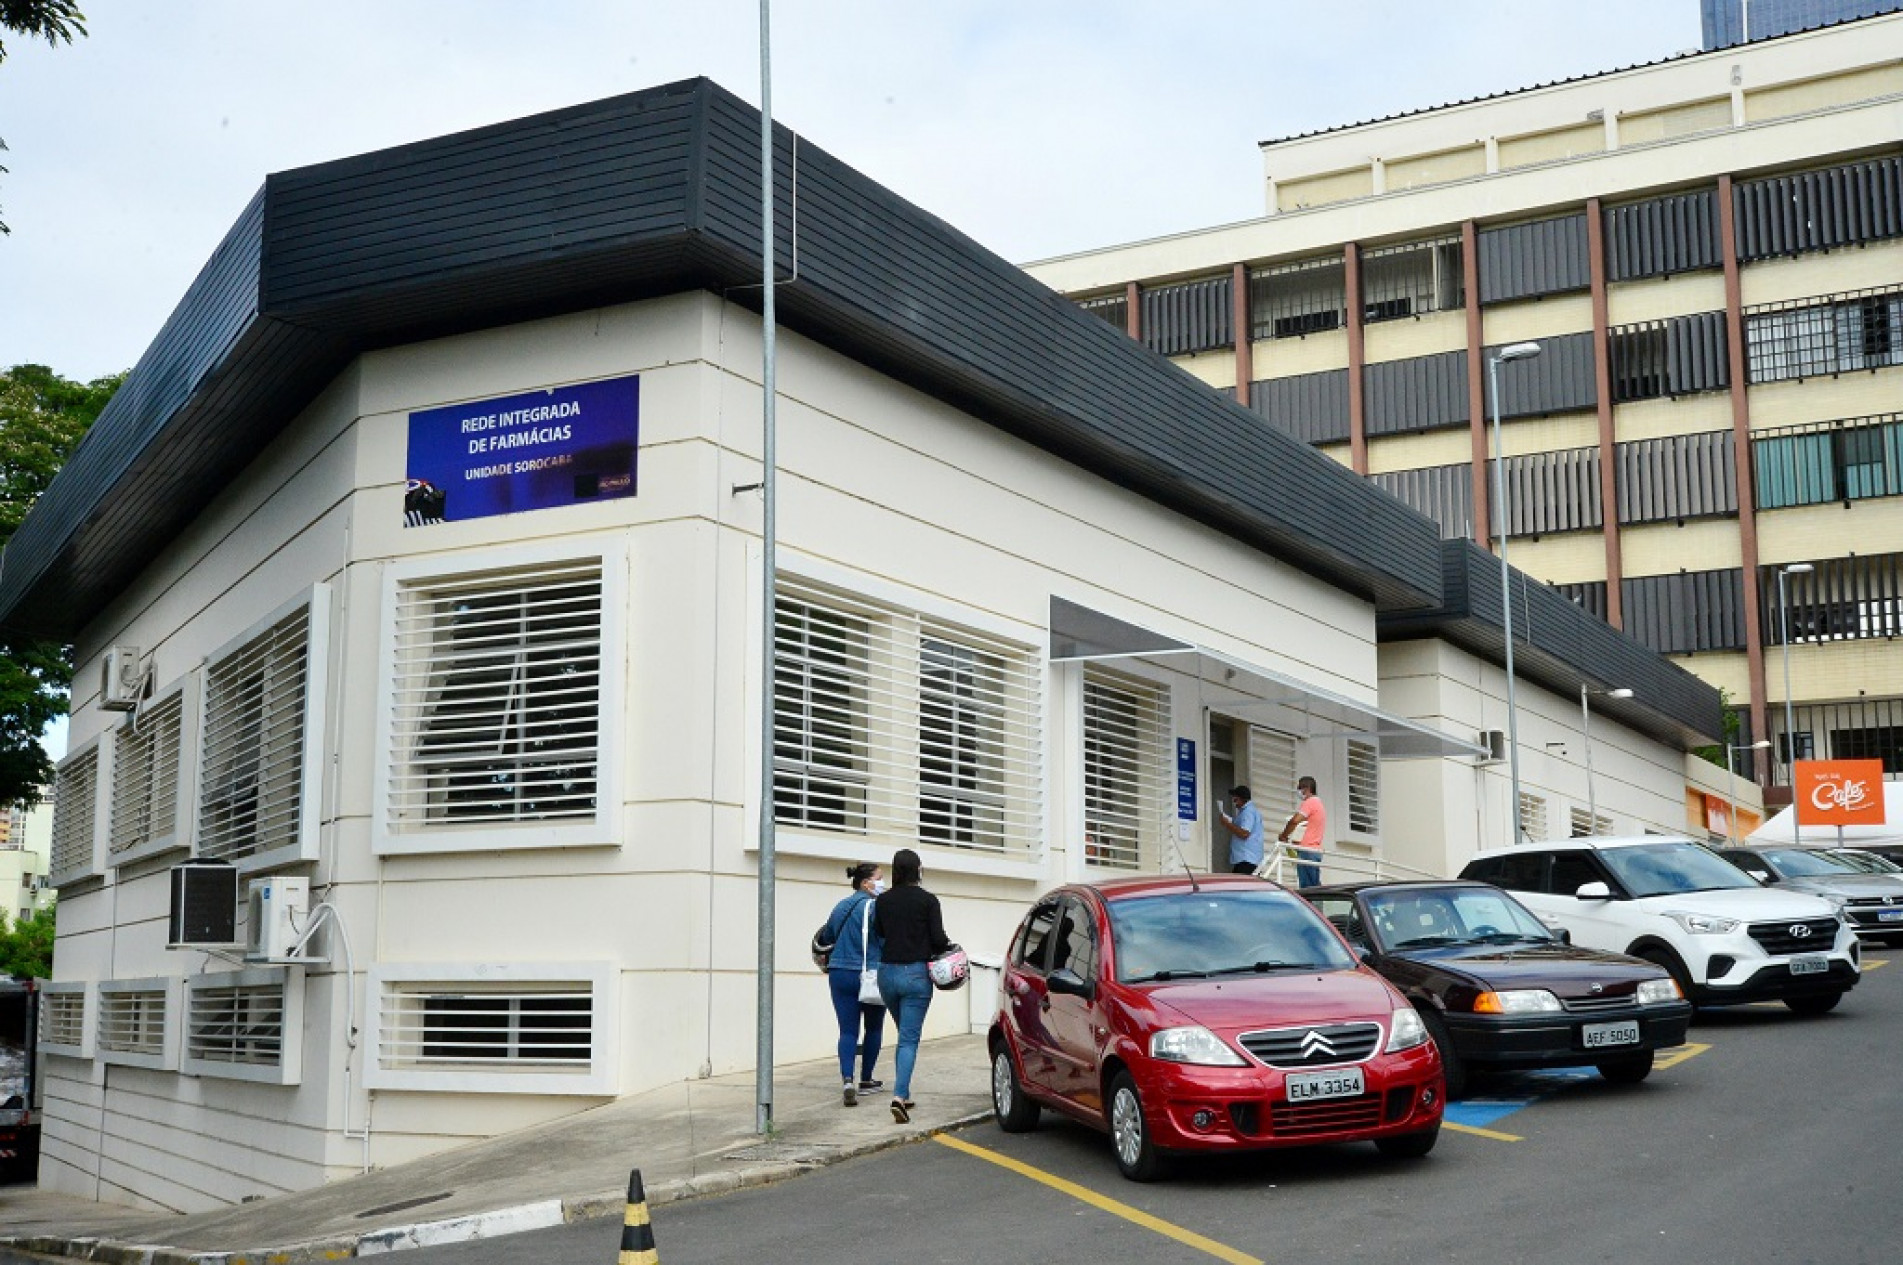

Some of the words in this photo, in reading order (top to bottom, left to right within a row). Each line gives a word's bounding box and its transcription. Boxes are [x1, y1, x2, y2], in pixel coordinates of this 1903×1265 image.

[461, 413, 497, 434] REDE
[499, 401, 580, 427] INTEGRADA
[468, 438, 487, 454] DE
[489, 425, 572, 450] FARMÁCIAS
[465, 462, 512, 480] UNIDADE
[1324, 1078, 1360, 1094] 3354
